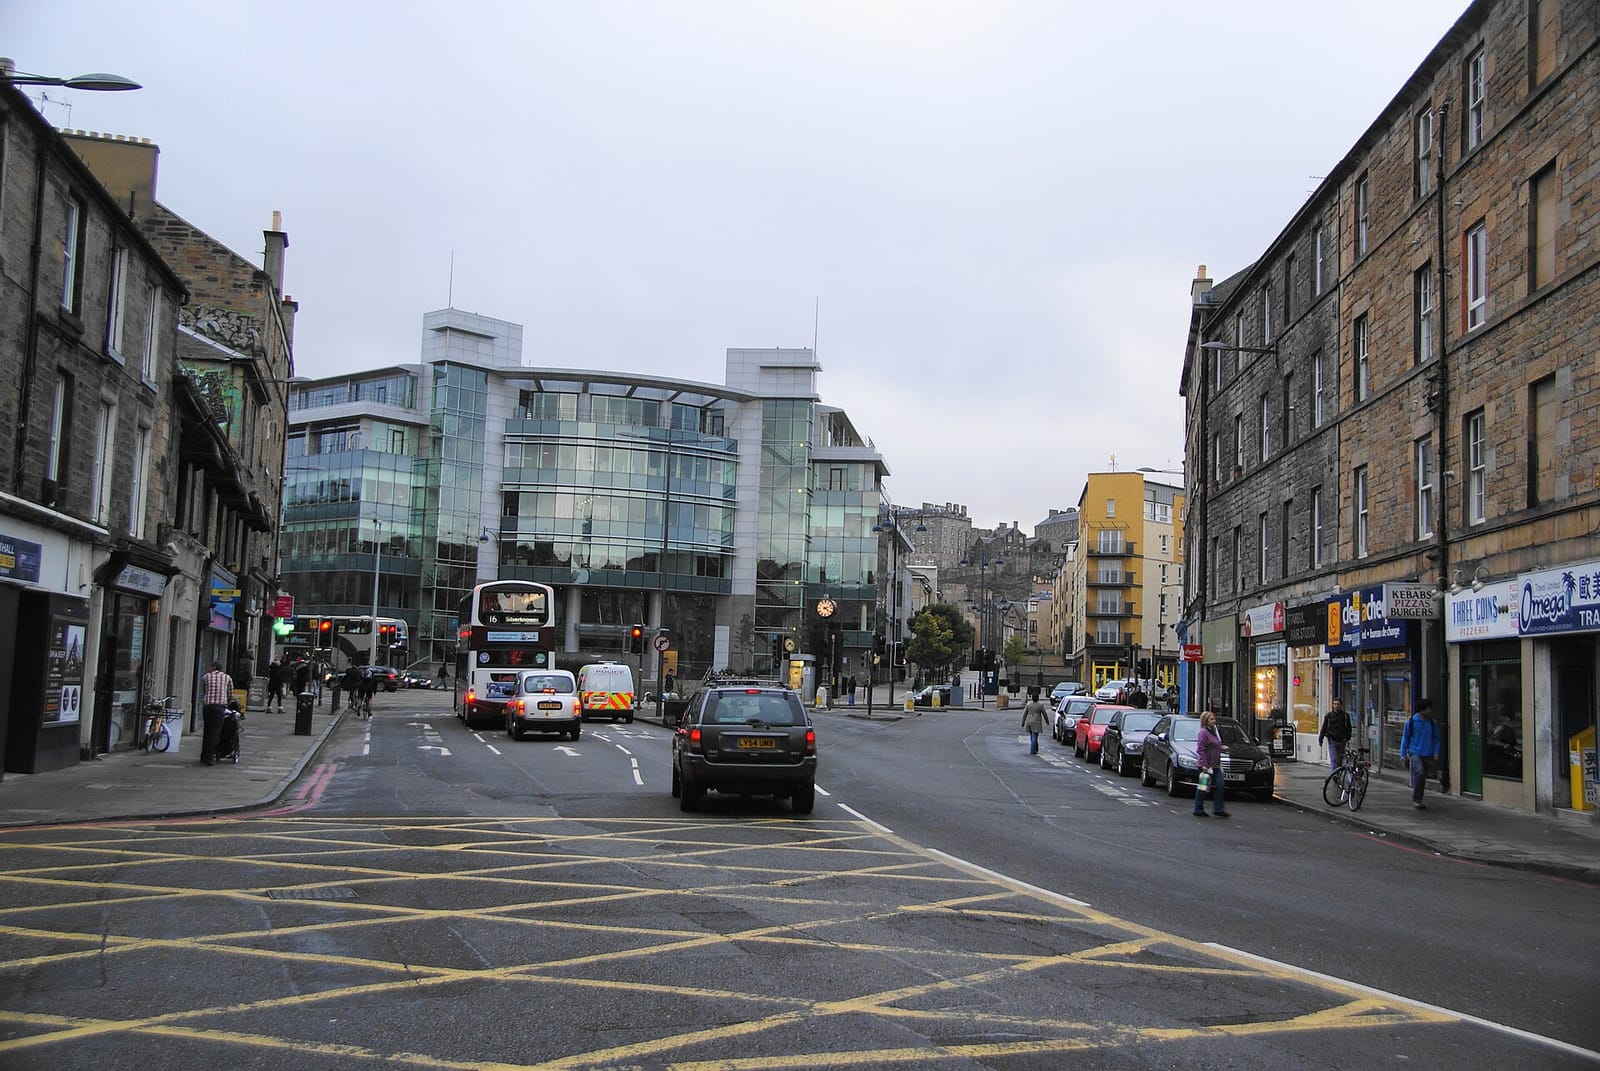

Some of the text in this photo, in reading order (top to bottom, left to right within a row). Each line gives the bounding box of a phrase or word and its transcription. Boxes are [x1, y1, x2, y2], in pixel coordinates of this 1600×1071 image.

[1392, 590, 1432, 599] KEBABS
[1394, 599, 1430, 608] PIZZAS
[1521, 581, 1565, 631] Omega
[1390, 607, 1433, 617] BURGERS
[1453, 595, 1498, 624] THREE COINS
[489, 615, 498, 623] 16
[1460, 626, 1489, 636] PIZZERIA
